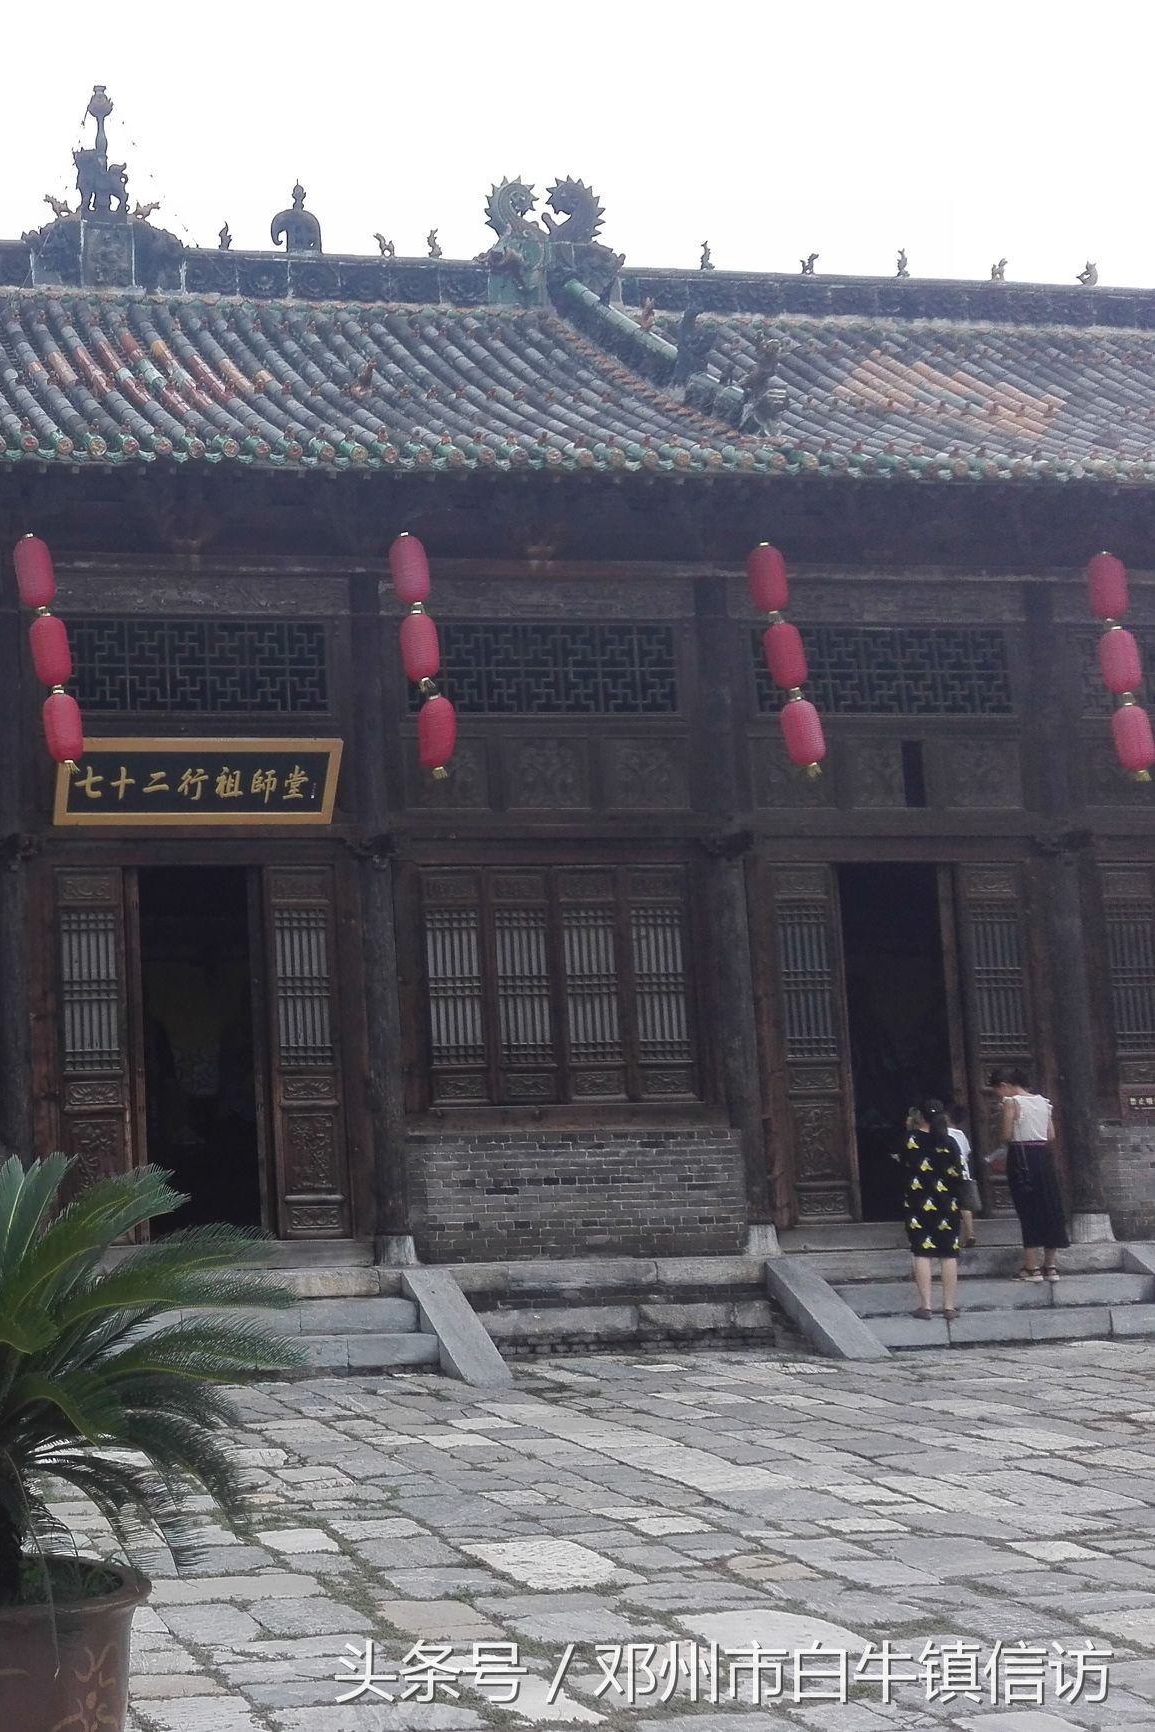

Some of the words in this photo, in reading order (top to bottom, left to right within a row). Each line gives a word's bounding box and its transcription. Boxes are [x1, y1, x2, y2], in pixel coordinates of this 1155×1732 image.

[75, 765, 309, 803] 七十二行祖師堂
